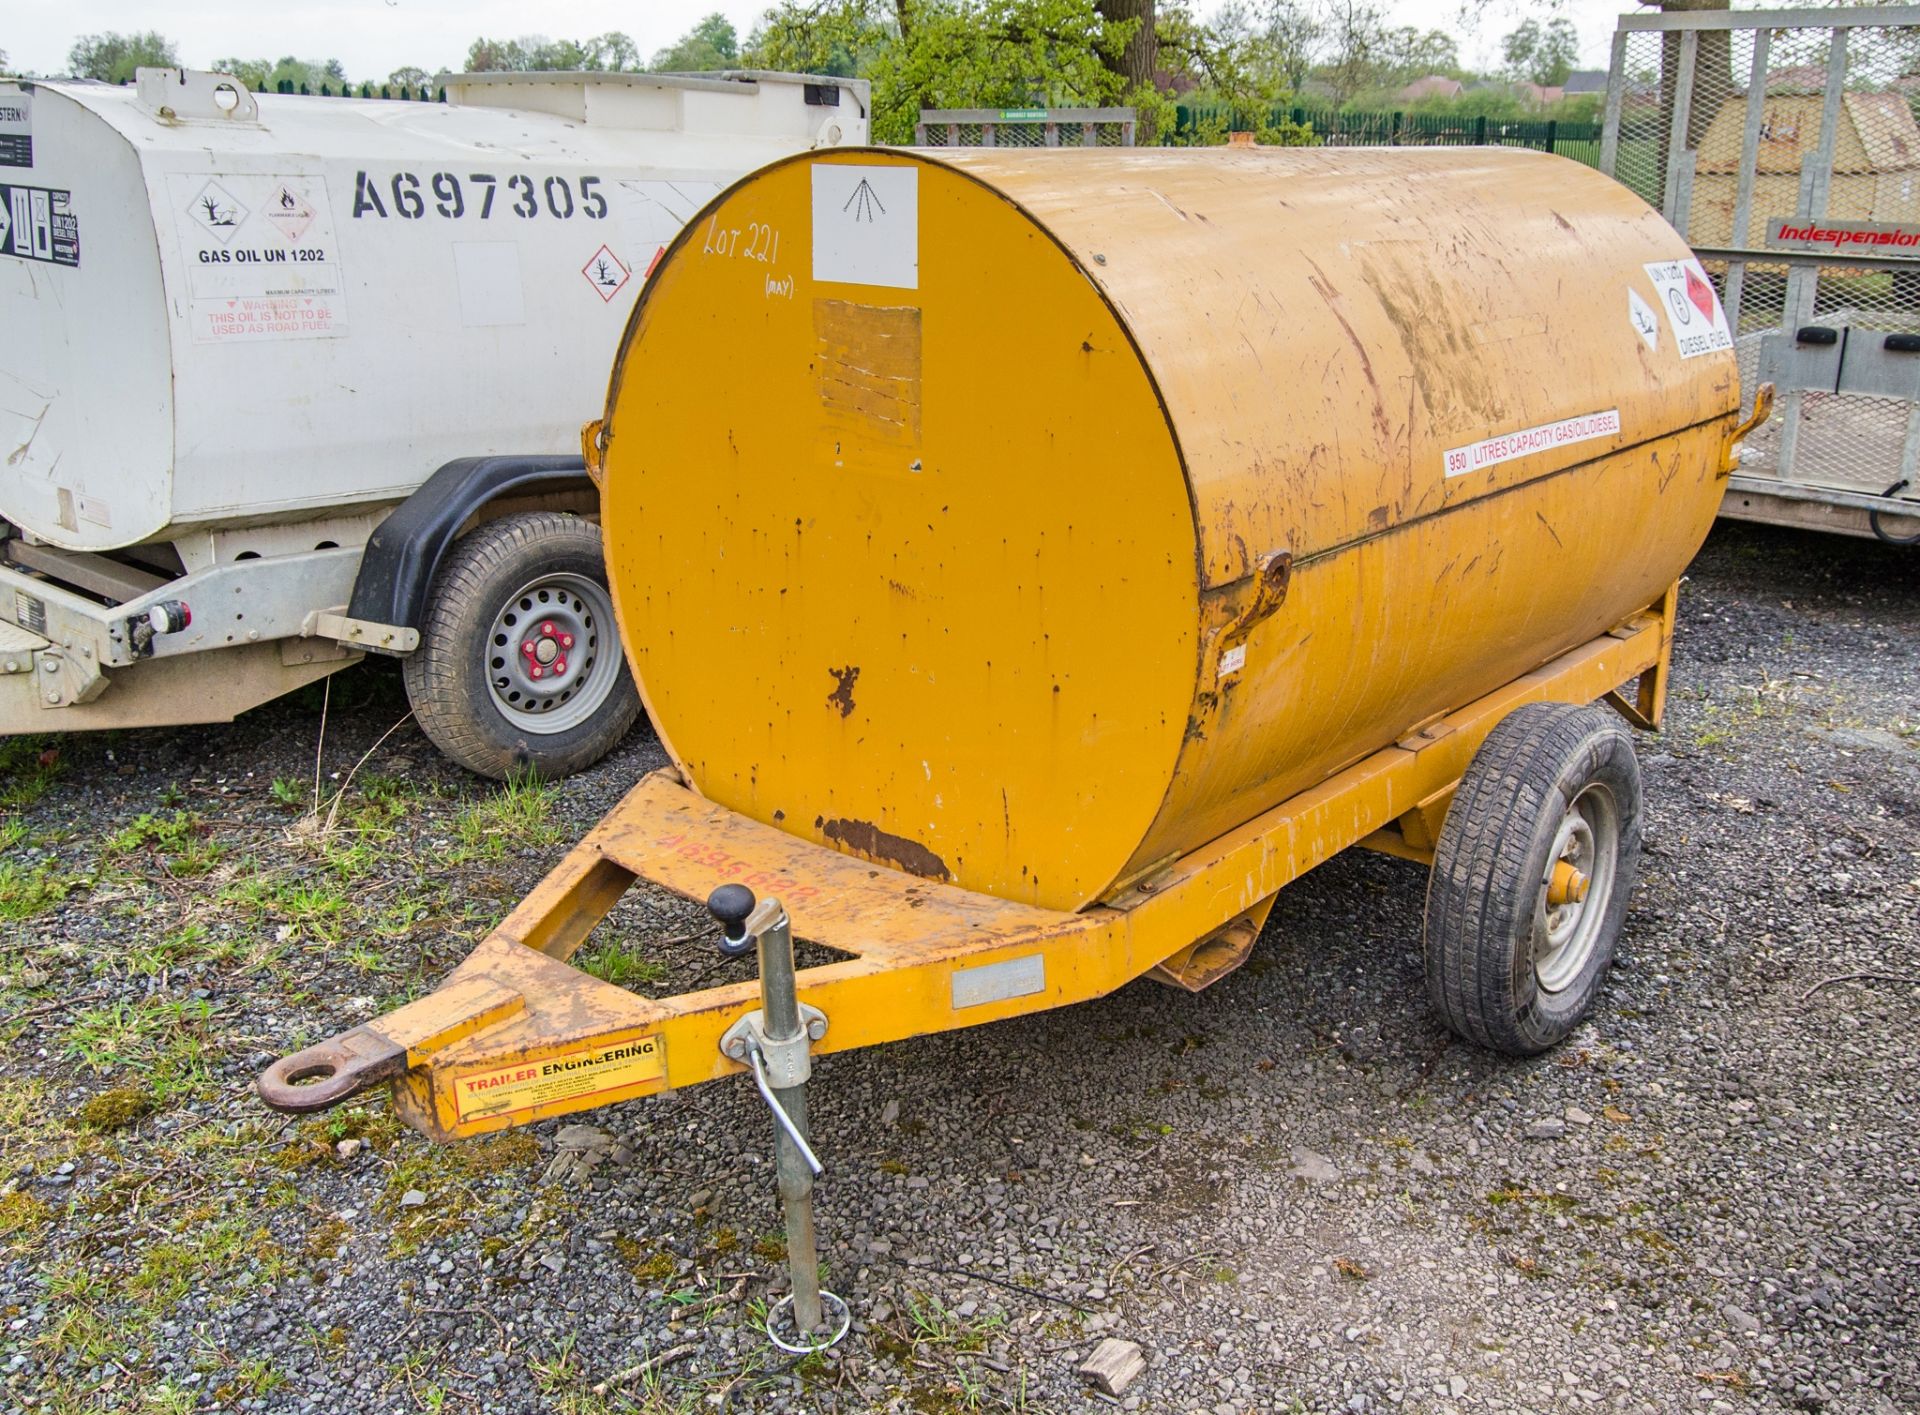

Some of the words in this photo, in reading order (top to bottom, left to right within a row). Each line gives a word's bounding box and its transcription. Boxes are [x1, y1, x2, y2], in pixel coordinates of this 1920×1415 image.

[352, 170, 608, 219] A697305
[199, 250, 231, 263] GAS
[236, 250, 261, 263] OIL
[265, 249, 286, 262] UN
[291, 249, 325, 262] 1202
[744, 223, 779, 264] 221
[208, 313, 235, 324] THIS
[238, 312, 258, 323] OIL
[260, 311, 271, 322] IS
[274, 310, 297, 321] NOT
[300, 309, 315, 320] TO
[317, 309, 332, 319] BE
[243, 299, 298, 310] WARNING
[212, 324, 245, 336] USED
[248, 323, 264, 334] AS
[267, 321, 299, 333] ROAD
[302, 320, 331, 331] FUEL
[1680, 335, 1710, 355] DIESEL
[1709, 330, 1731, 347] FUEL
[1449, 452, 1467, 471] 950
[1472, 442, 1508, 465] LITRES
[1509, 428, 1554, 454] CAPACITY
[466, 1068, 537, 1092] TRAILER
[542, 1043, 654, 1076] ENGINEERING
